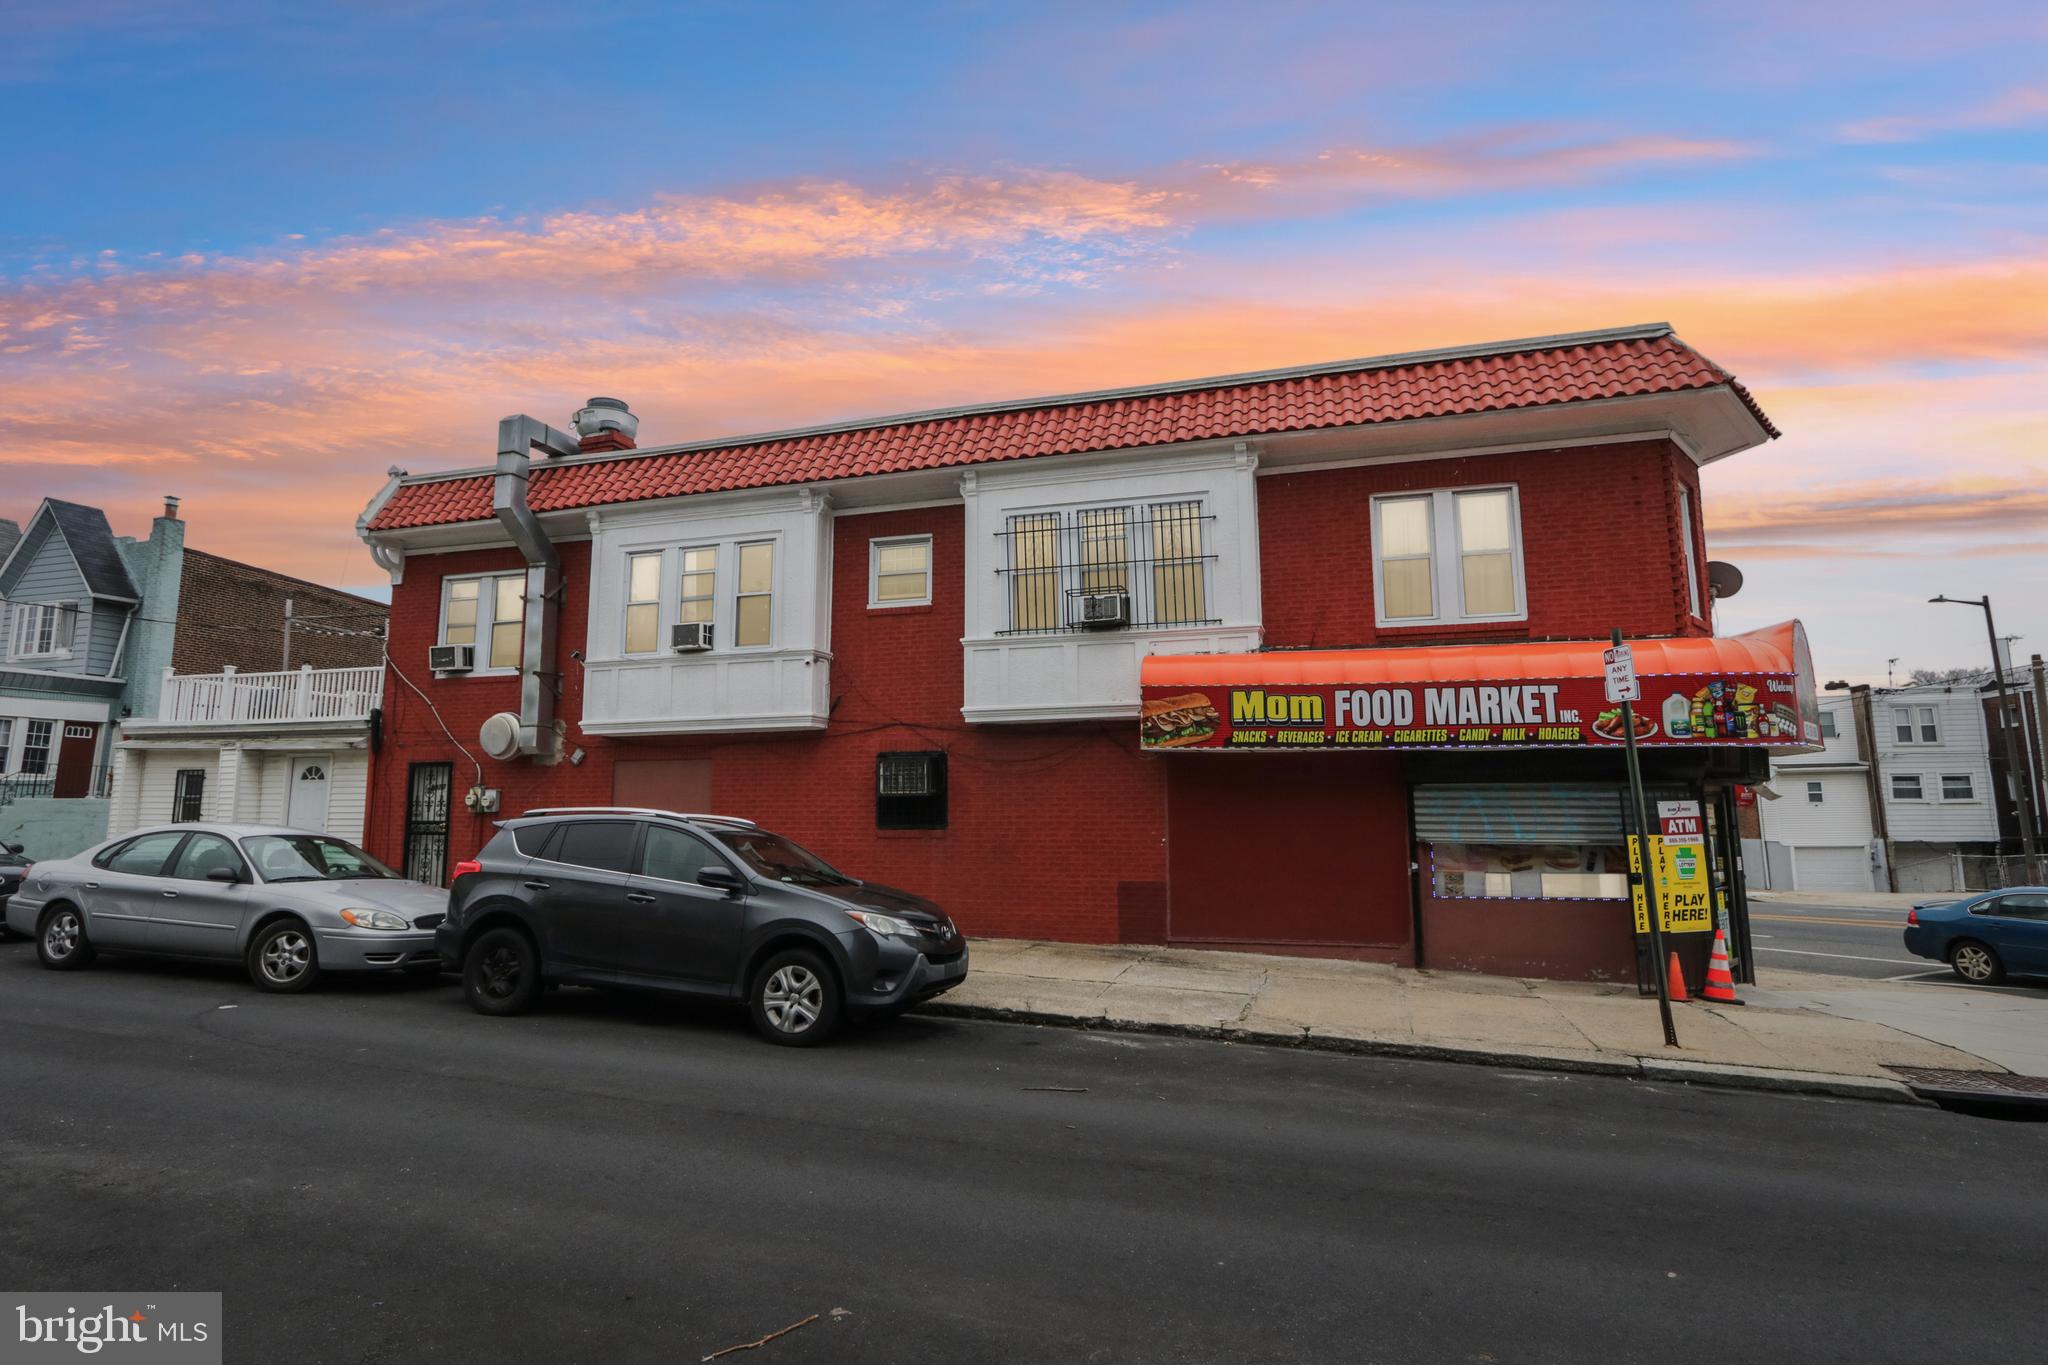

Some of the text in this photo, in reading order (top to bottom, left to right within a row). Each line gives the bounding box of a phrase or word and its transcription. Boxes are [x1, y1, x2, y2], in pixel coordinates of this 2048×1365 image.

[1605, 650, 1614, 663] NO
[1612, 664, 1627, 674] ANY
[1613, 674, 1629, 684] TIME
[1232, 685, 1582, 727] Mom FOOD MARKET INC.
[1232, 727, 1580, 743] SNACKS BEVERAGES ICE CREAM CIGARETTES CANDY MILK HOAGIES
[1668, 818, 1697, 833] ATM
[1675, 893, 1705, 906] PLAY
[1662, 893, 1670, 929] HERE
[1672, 908, 1708, 922] HERE!
